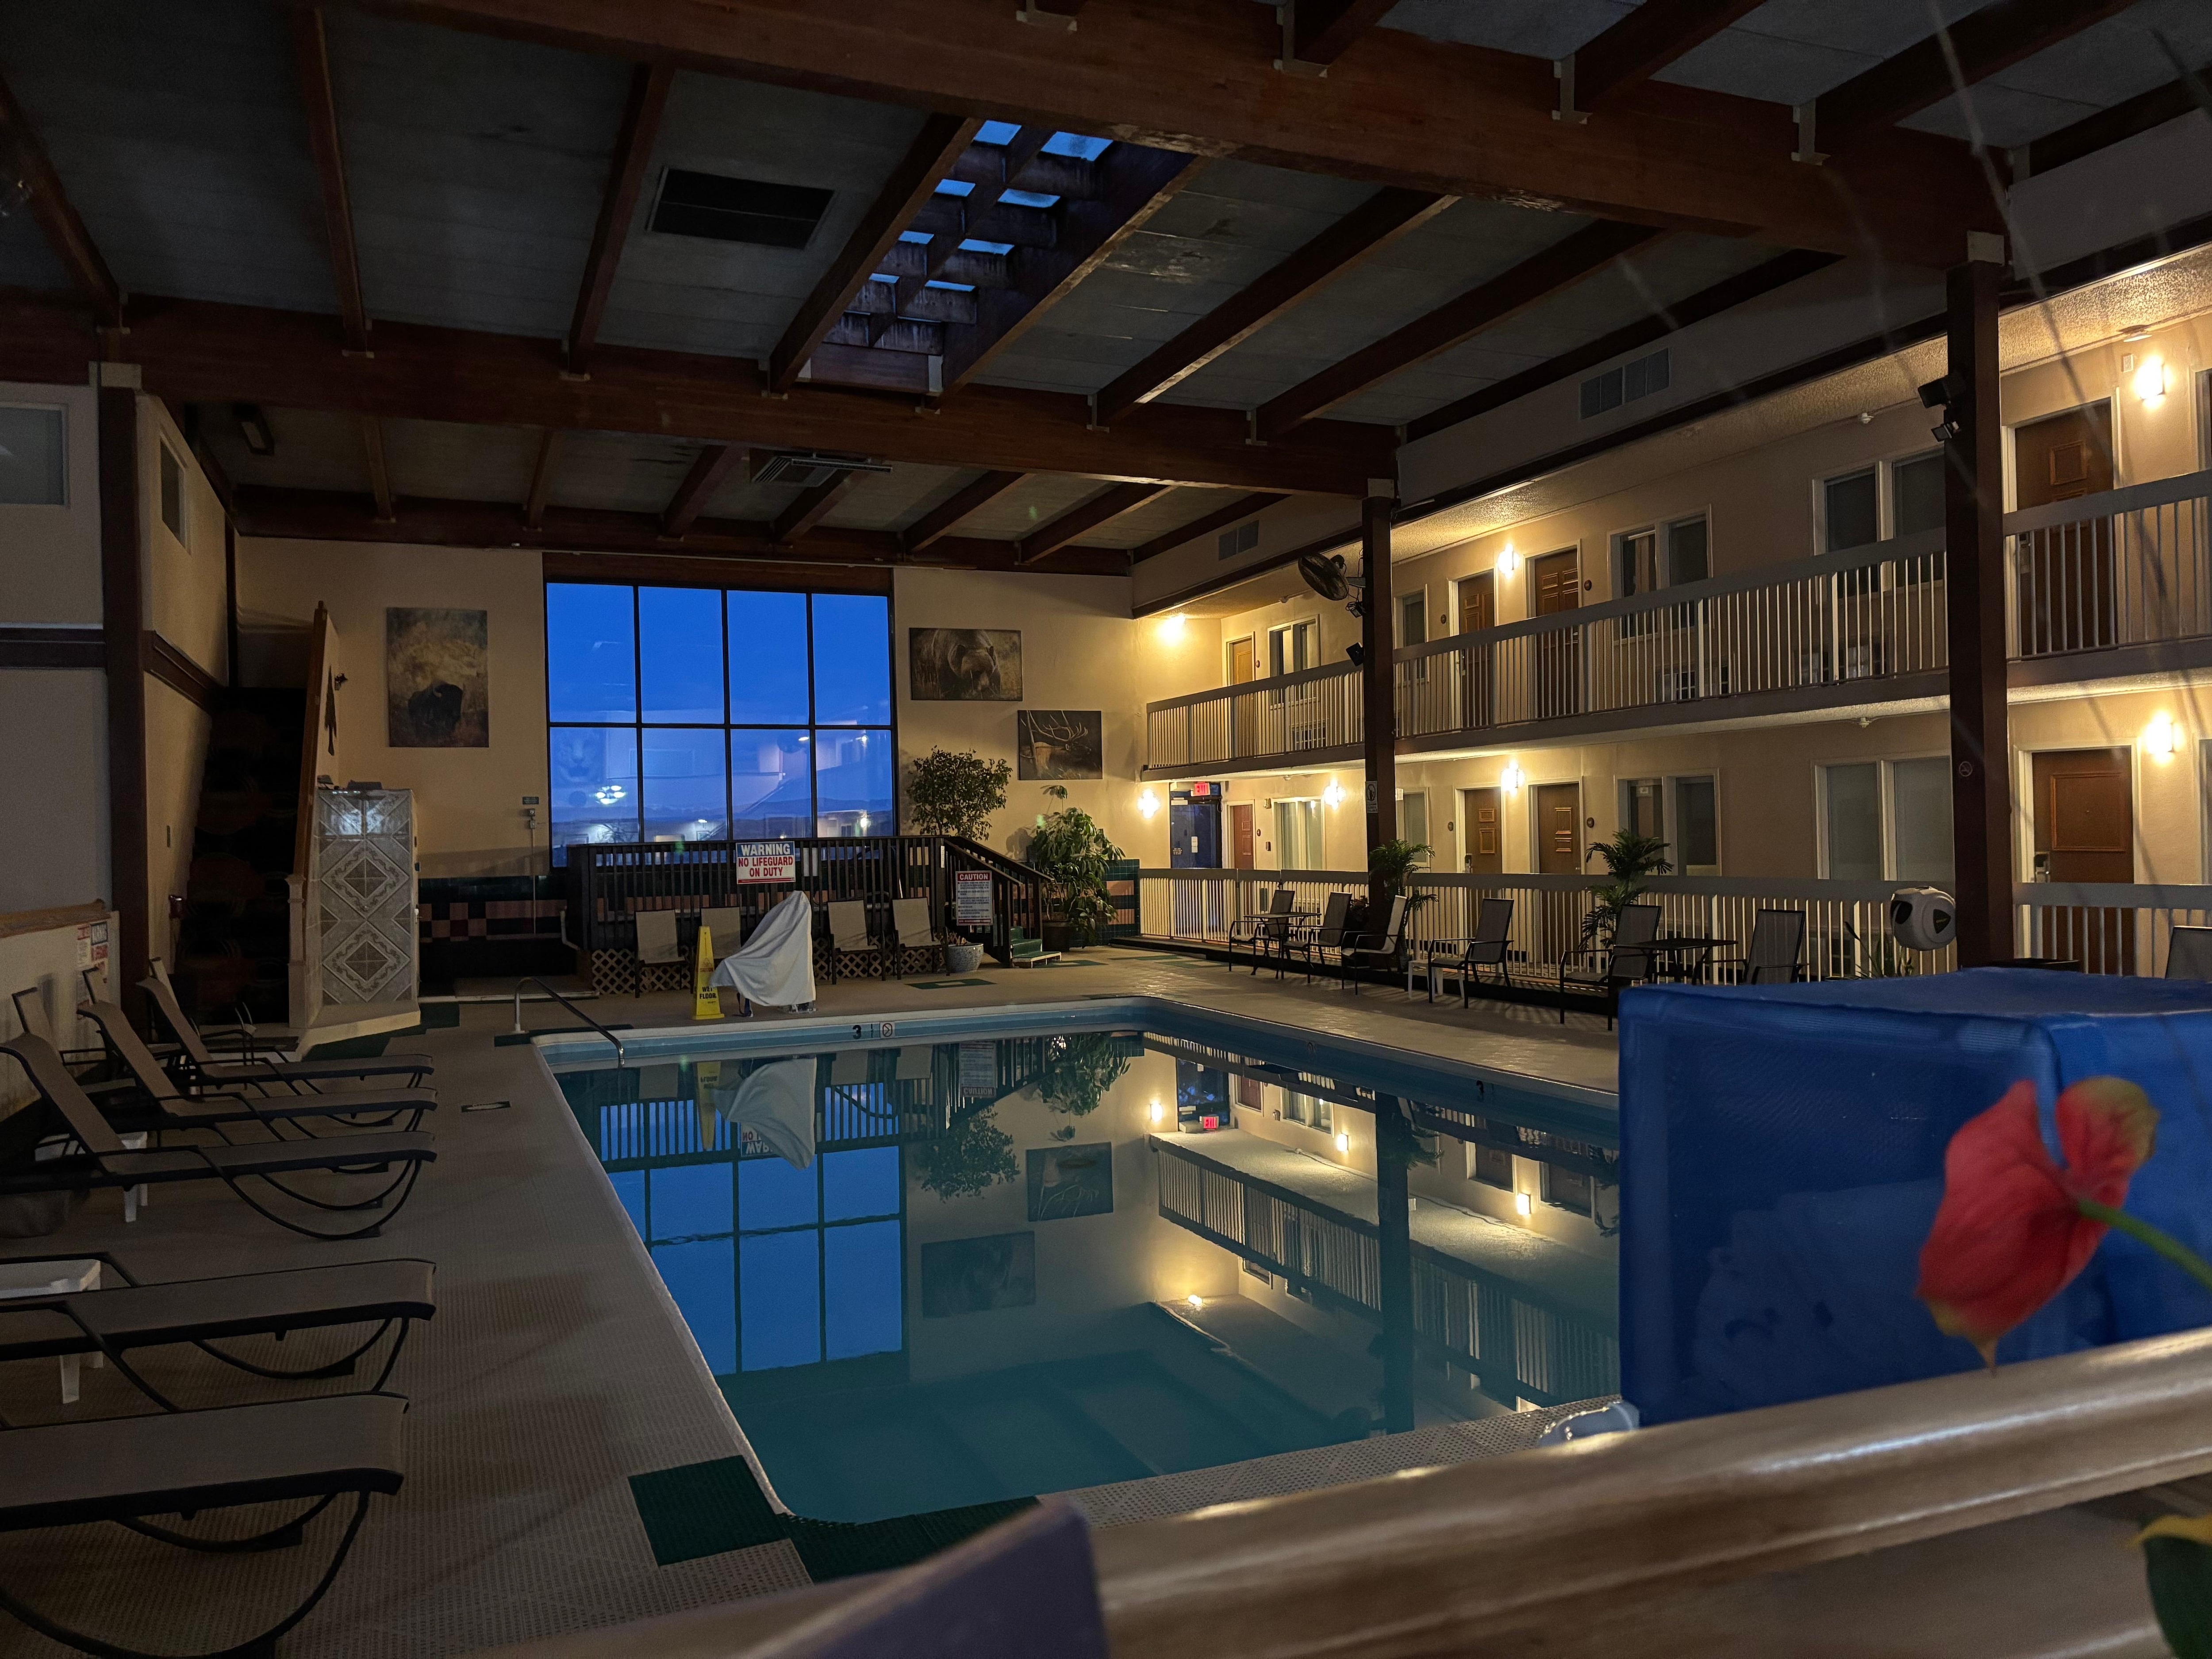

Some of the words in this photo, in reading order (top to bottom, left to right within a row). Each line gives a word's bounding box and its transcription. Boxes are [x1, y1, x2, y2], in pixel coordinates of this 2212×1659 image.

[741, 844, 791, 856] WARNING
[739, 858, 749, 867] NO
[753, 856, 793, 866] LIFEGUARD
[749, 868, 760, 877] ON
[764, 867, 783, 876] DUTY
[853, 1025, 861, 1038] 3
